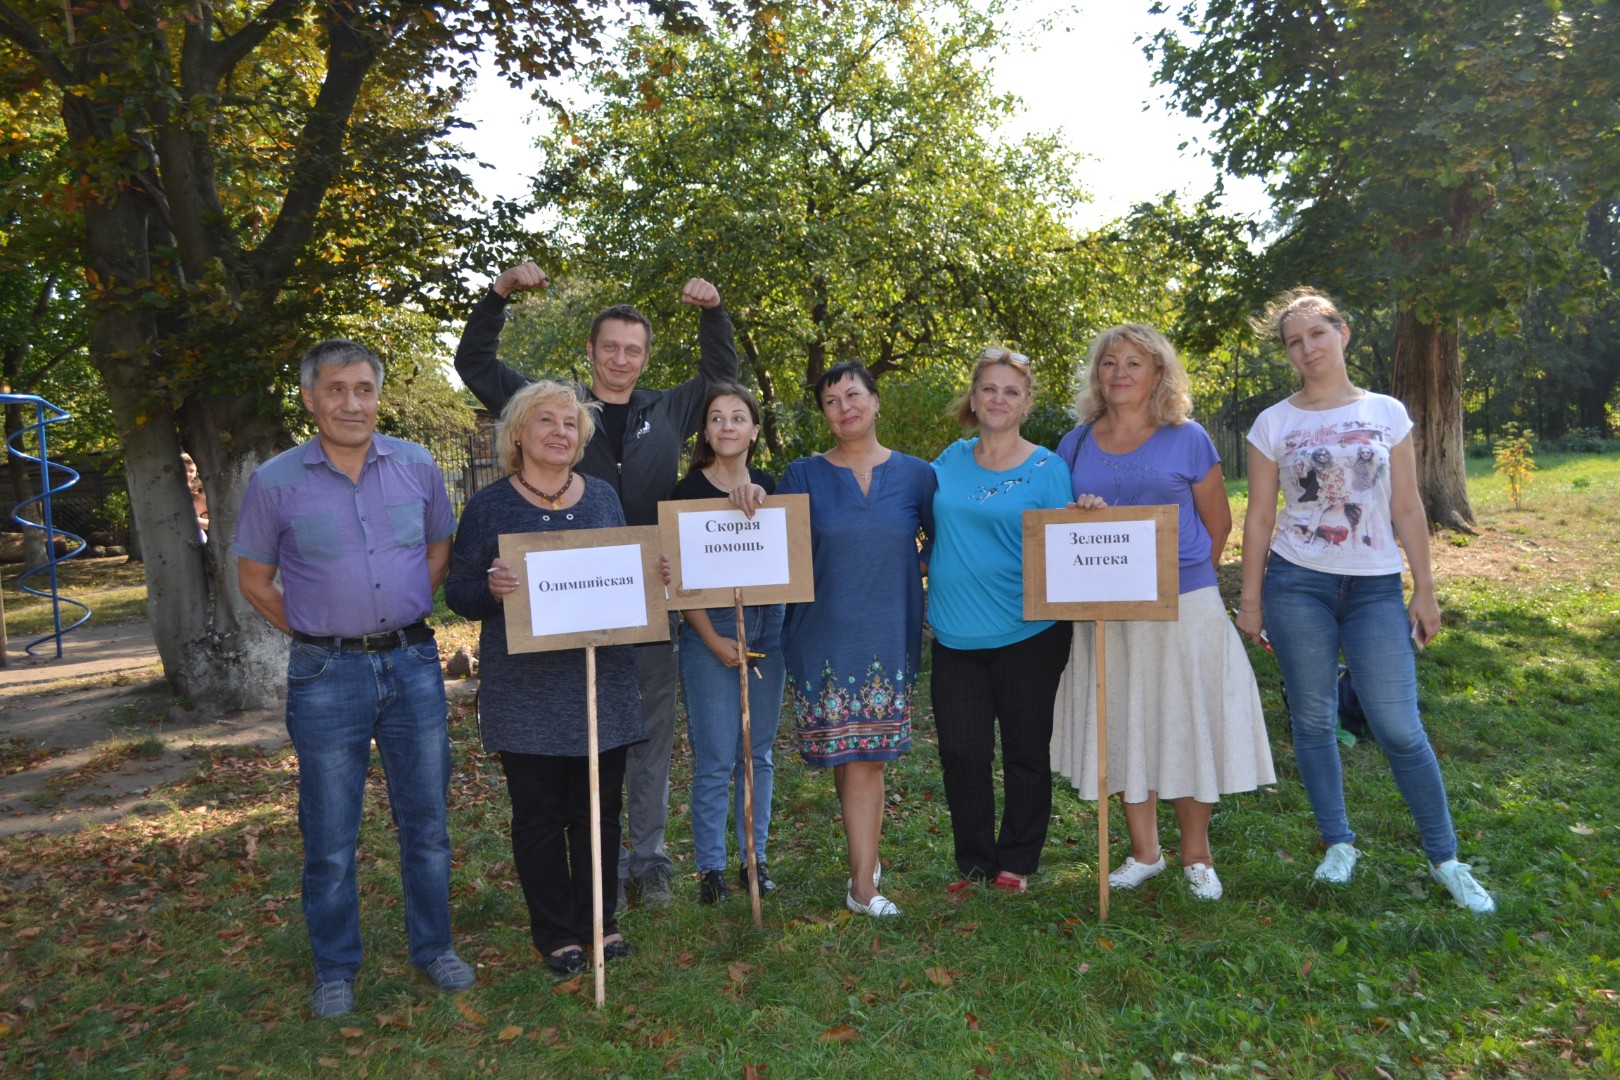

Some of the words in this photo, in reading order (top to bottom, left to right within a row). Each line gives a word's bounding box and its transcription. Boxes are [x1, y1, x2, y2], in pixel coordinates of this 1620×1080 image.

[705, 519, 761, 534] Скорая
[1069, 532, 1130, 545] Зеленая
[704, 541, 764, 554] помощь
[1072, 553, 1128, 566] Аптека
[538, 576, 634, 592] Олимпийская
